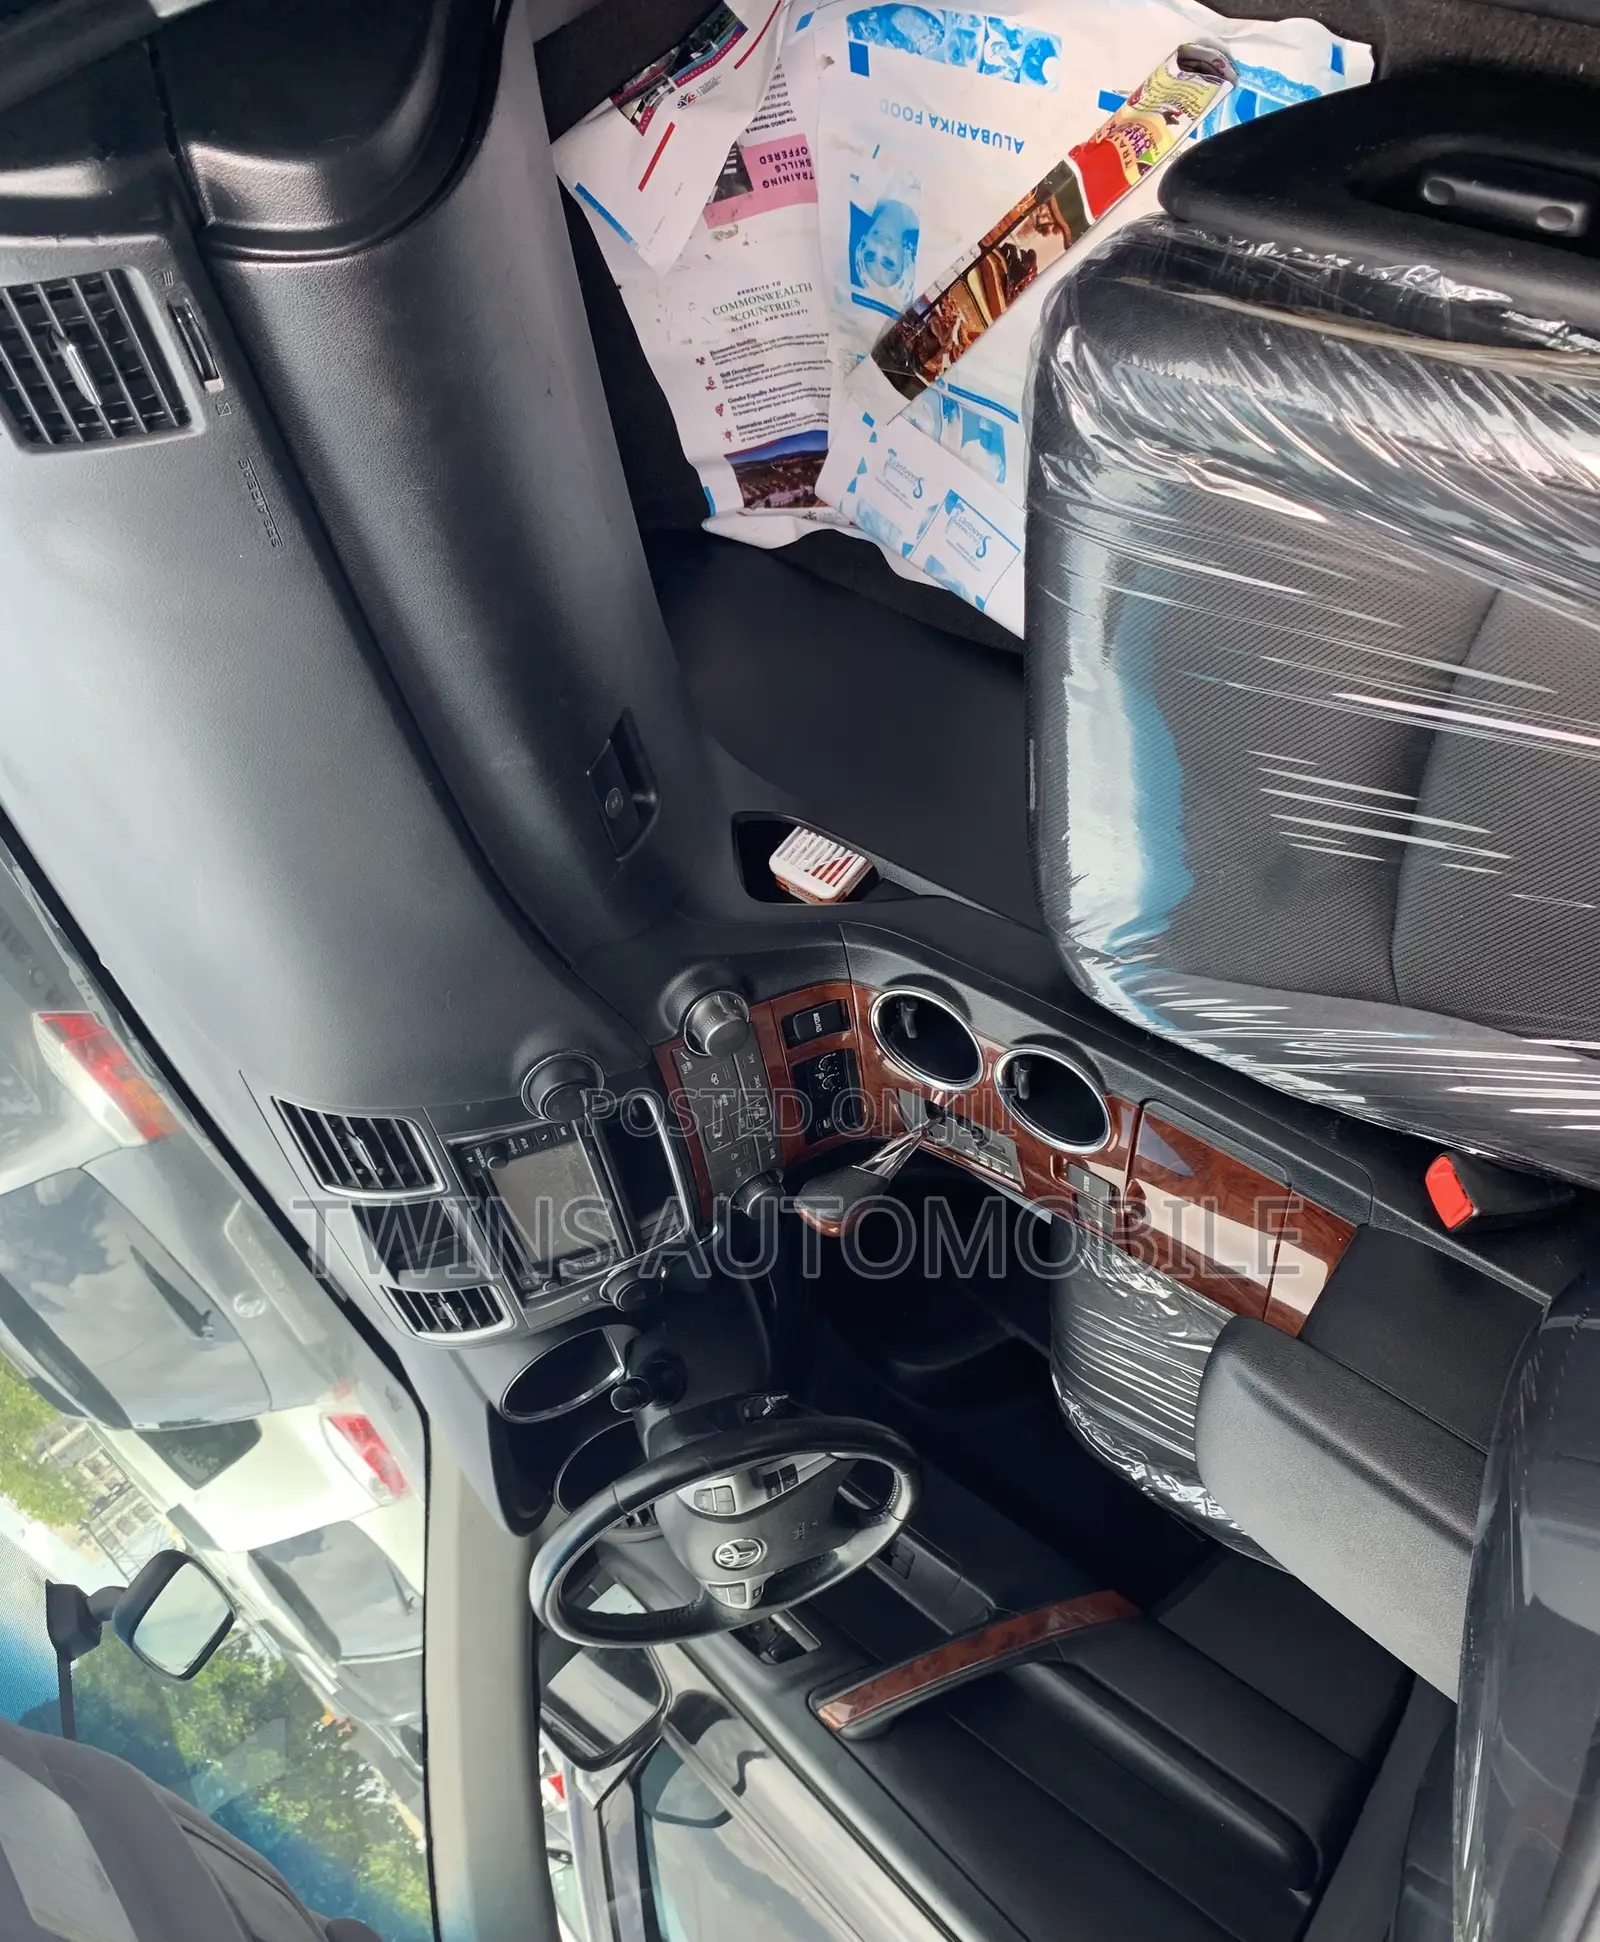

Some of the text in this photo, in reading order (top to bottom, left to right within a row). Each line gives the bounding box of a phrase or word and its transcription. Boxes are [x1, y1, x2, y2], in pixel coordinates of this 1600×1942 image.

[880, 99, 1025, 154] ALUBARIKA FOOD
[759, 146, 809, 165] OFFERED
[775, 157, 812, 173] SKILLS
[762, 172, 814, 189] TRAINING
[737, 280, 782, 296] BENEFITS TO
[712, 282, 813, 316] COMMONWEALTH
[733, 298, 801, 323] COUNTRIES
[764, 314, 779, 322] AND
[780, 308, 809, 319] SOCIETY
[239, 458, 271, 516] AIRBAG
[956, 516, 986, 540] BANQUET
[752, 1074, 763, 1089] SYNC
